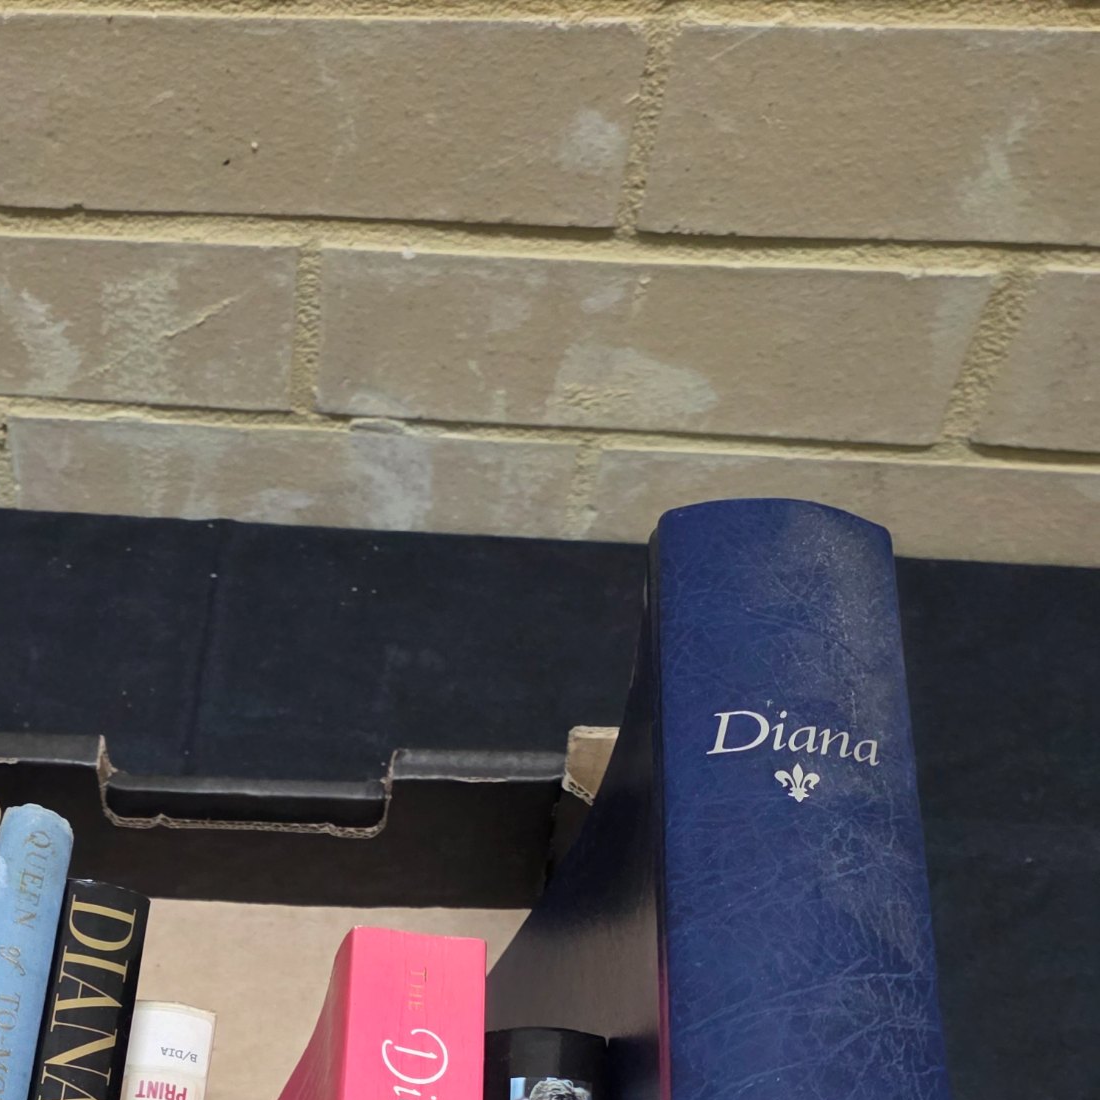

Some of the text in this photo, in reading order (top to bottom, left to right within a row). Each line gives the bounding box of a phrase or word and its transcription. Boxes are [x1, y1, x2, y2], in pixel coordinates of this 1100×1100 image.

[706, 710, 880, 767] Diana
[13, 831, 54, 929] QUEEN
[408, 967, 427, 1011] THE
[160, 1046, 198, 1064] B/DIA
